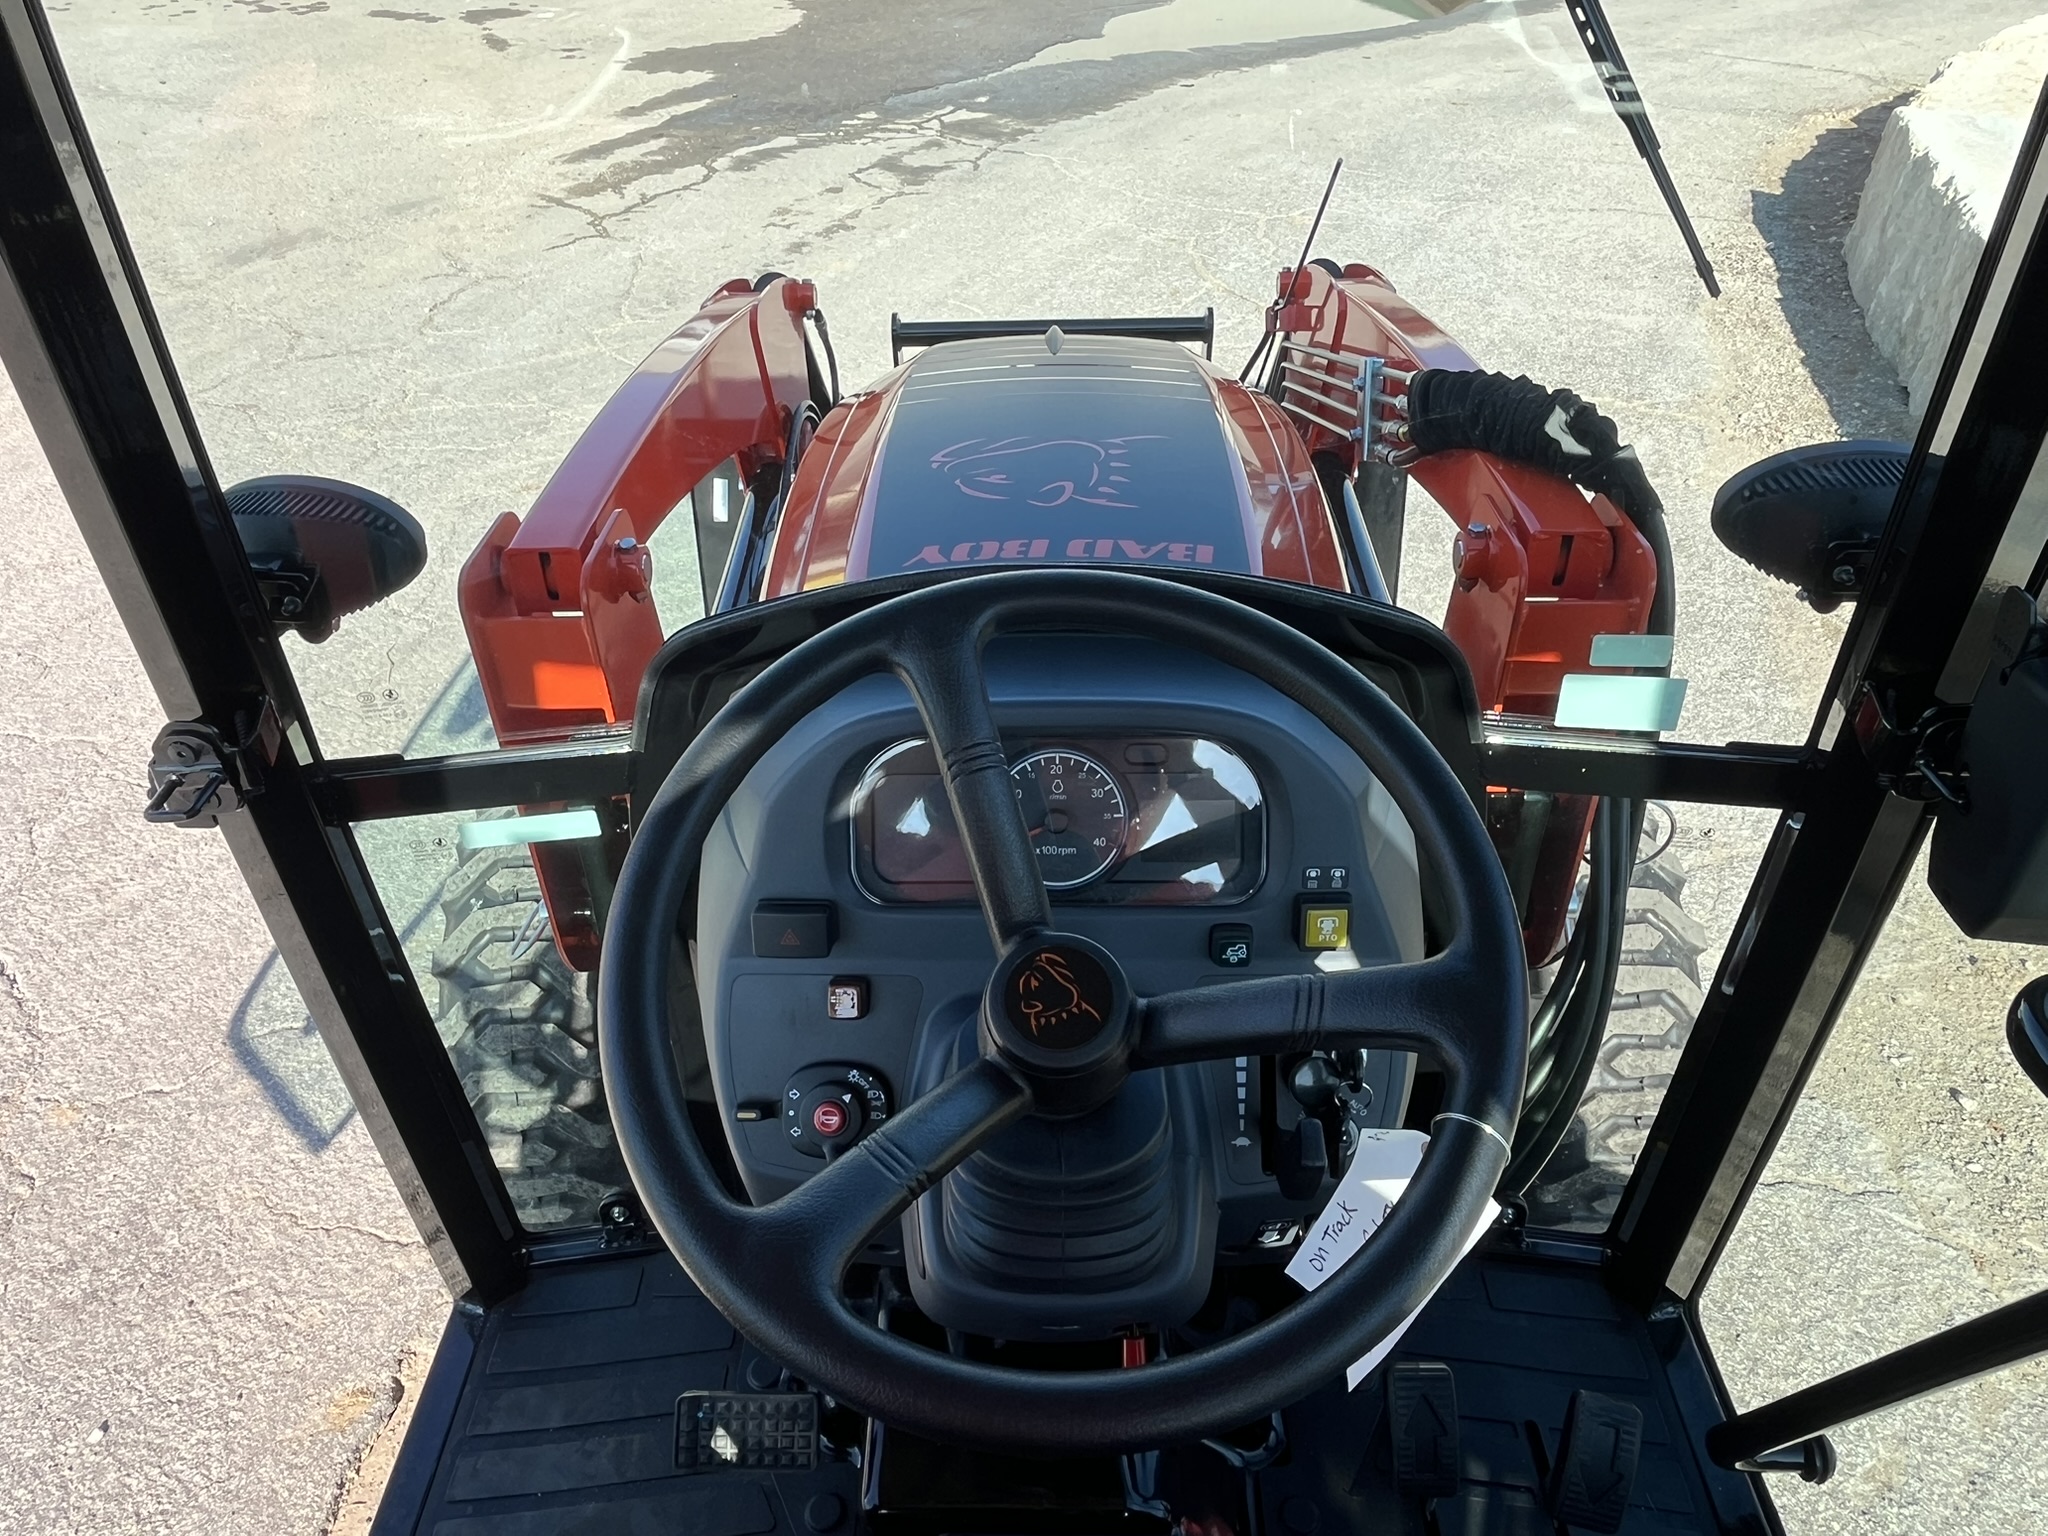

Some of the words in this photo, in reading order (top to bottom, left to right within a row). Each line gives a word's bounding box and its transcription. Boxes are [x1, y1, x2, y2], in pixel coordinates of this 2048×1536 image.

[902, 539, 1050, 567] BOY
[1066, 539, 1215, 564] BAD
[1050, 765, 1063, 775] 20
[1091, 788, 1104, 798] 30
[1093, 837, 1106, 847] 40
[1318, 934, 1338, 942] PTO
[1349, 1099, 1368, 1117] AUTO
[1321, 1199, 1358, 1244] Track
